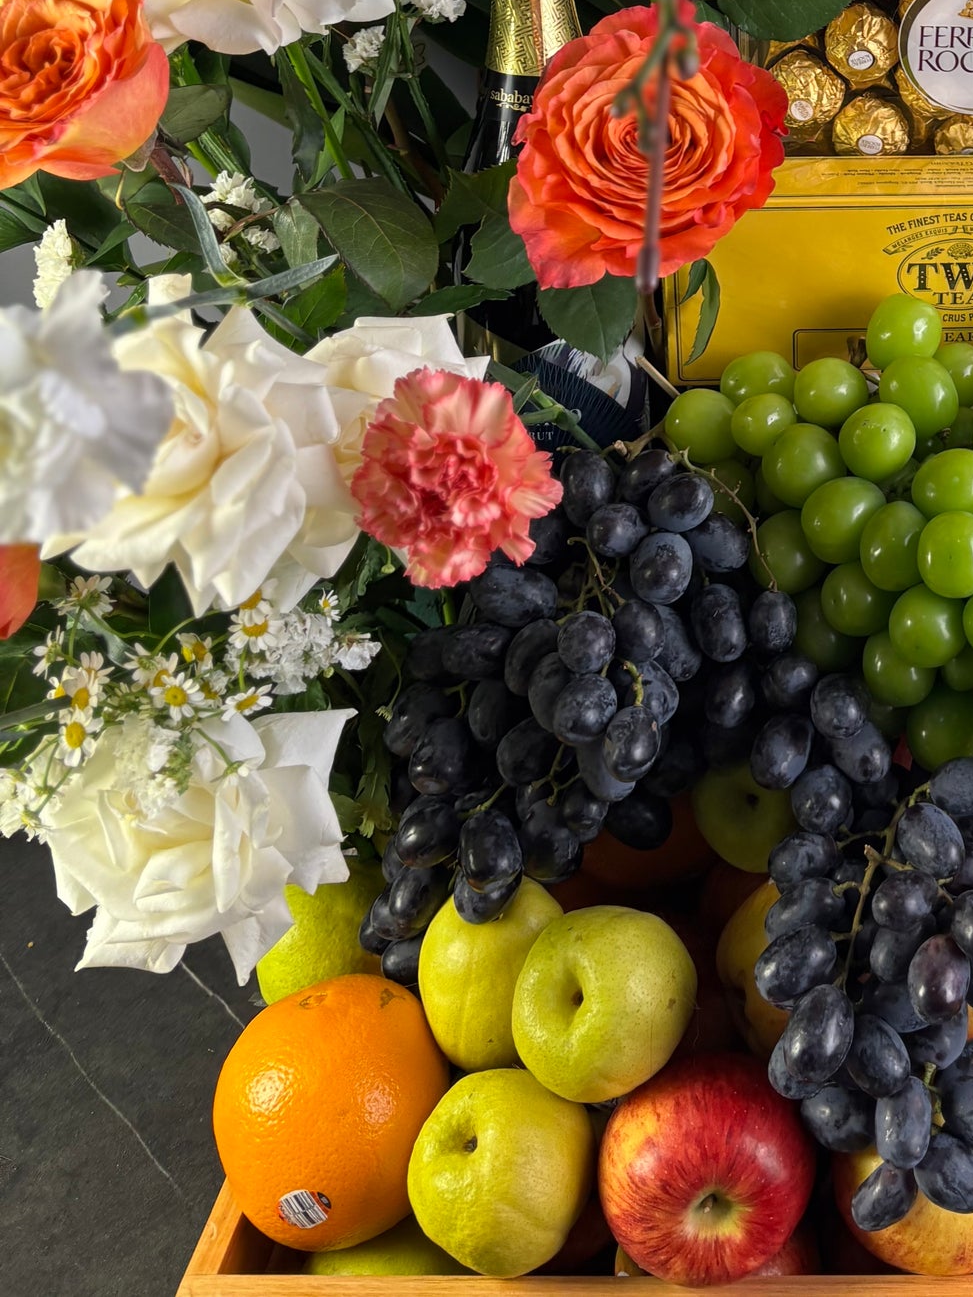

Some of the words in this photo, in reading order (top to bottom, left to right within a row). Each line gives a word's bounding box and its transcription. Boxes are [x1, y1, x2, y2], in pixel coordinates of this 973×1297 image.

[886, 222, 907, 235] THE
[907, 214, 941, 230] FINEST
[943, 212, 968, 223] TEAS
[942, 313, 966, 322] CRUS
[529, 431, 554, 441] RUT
